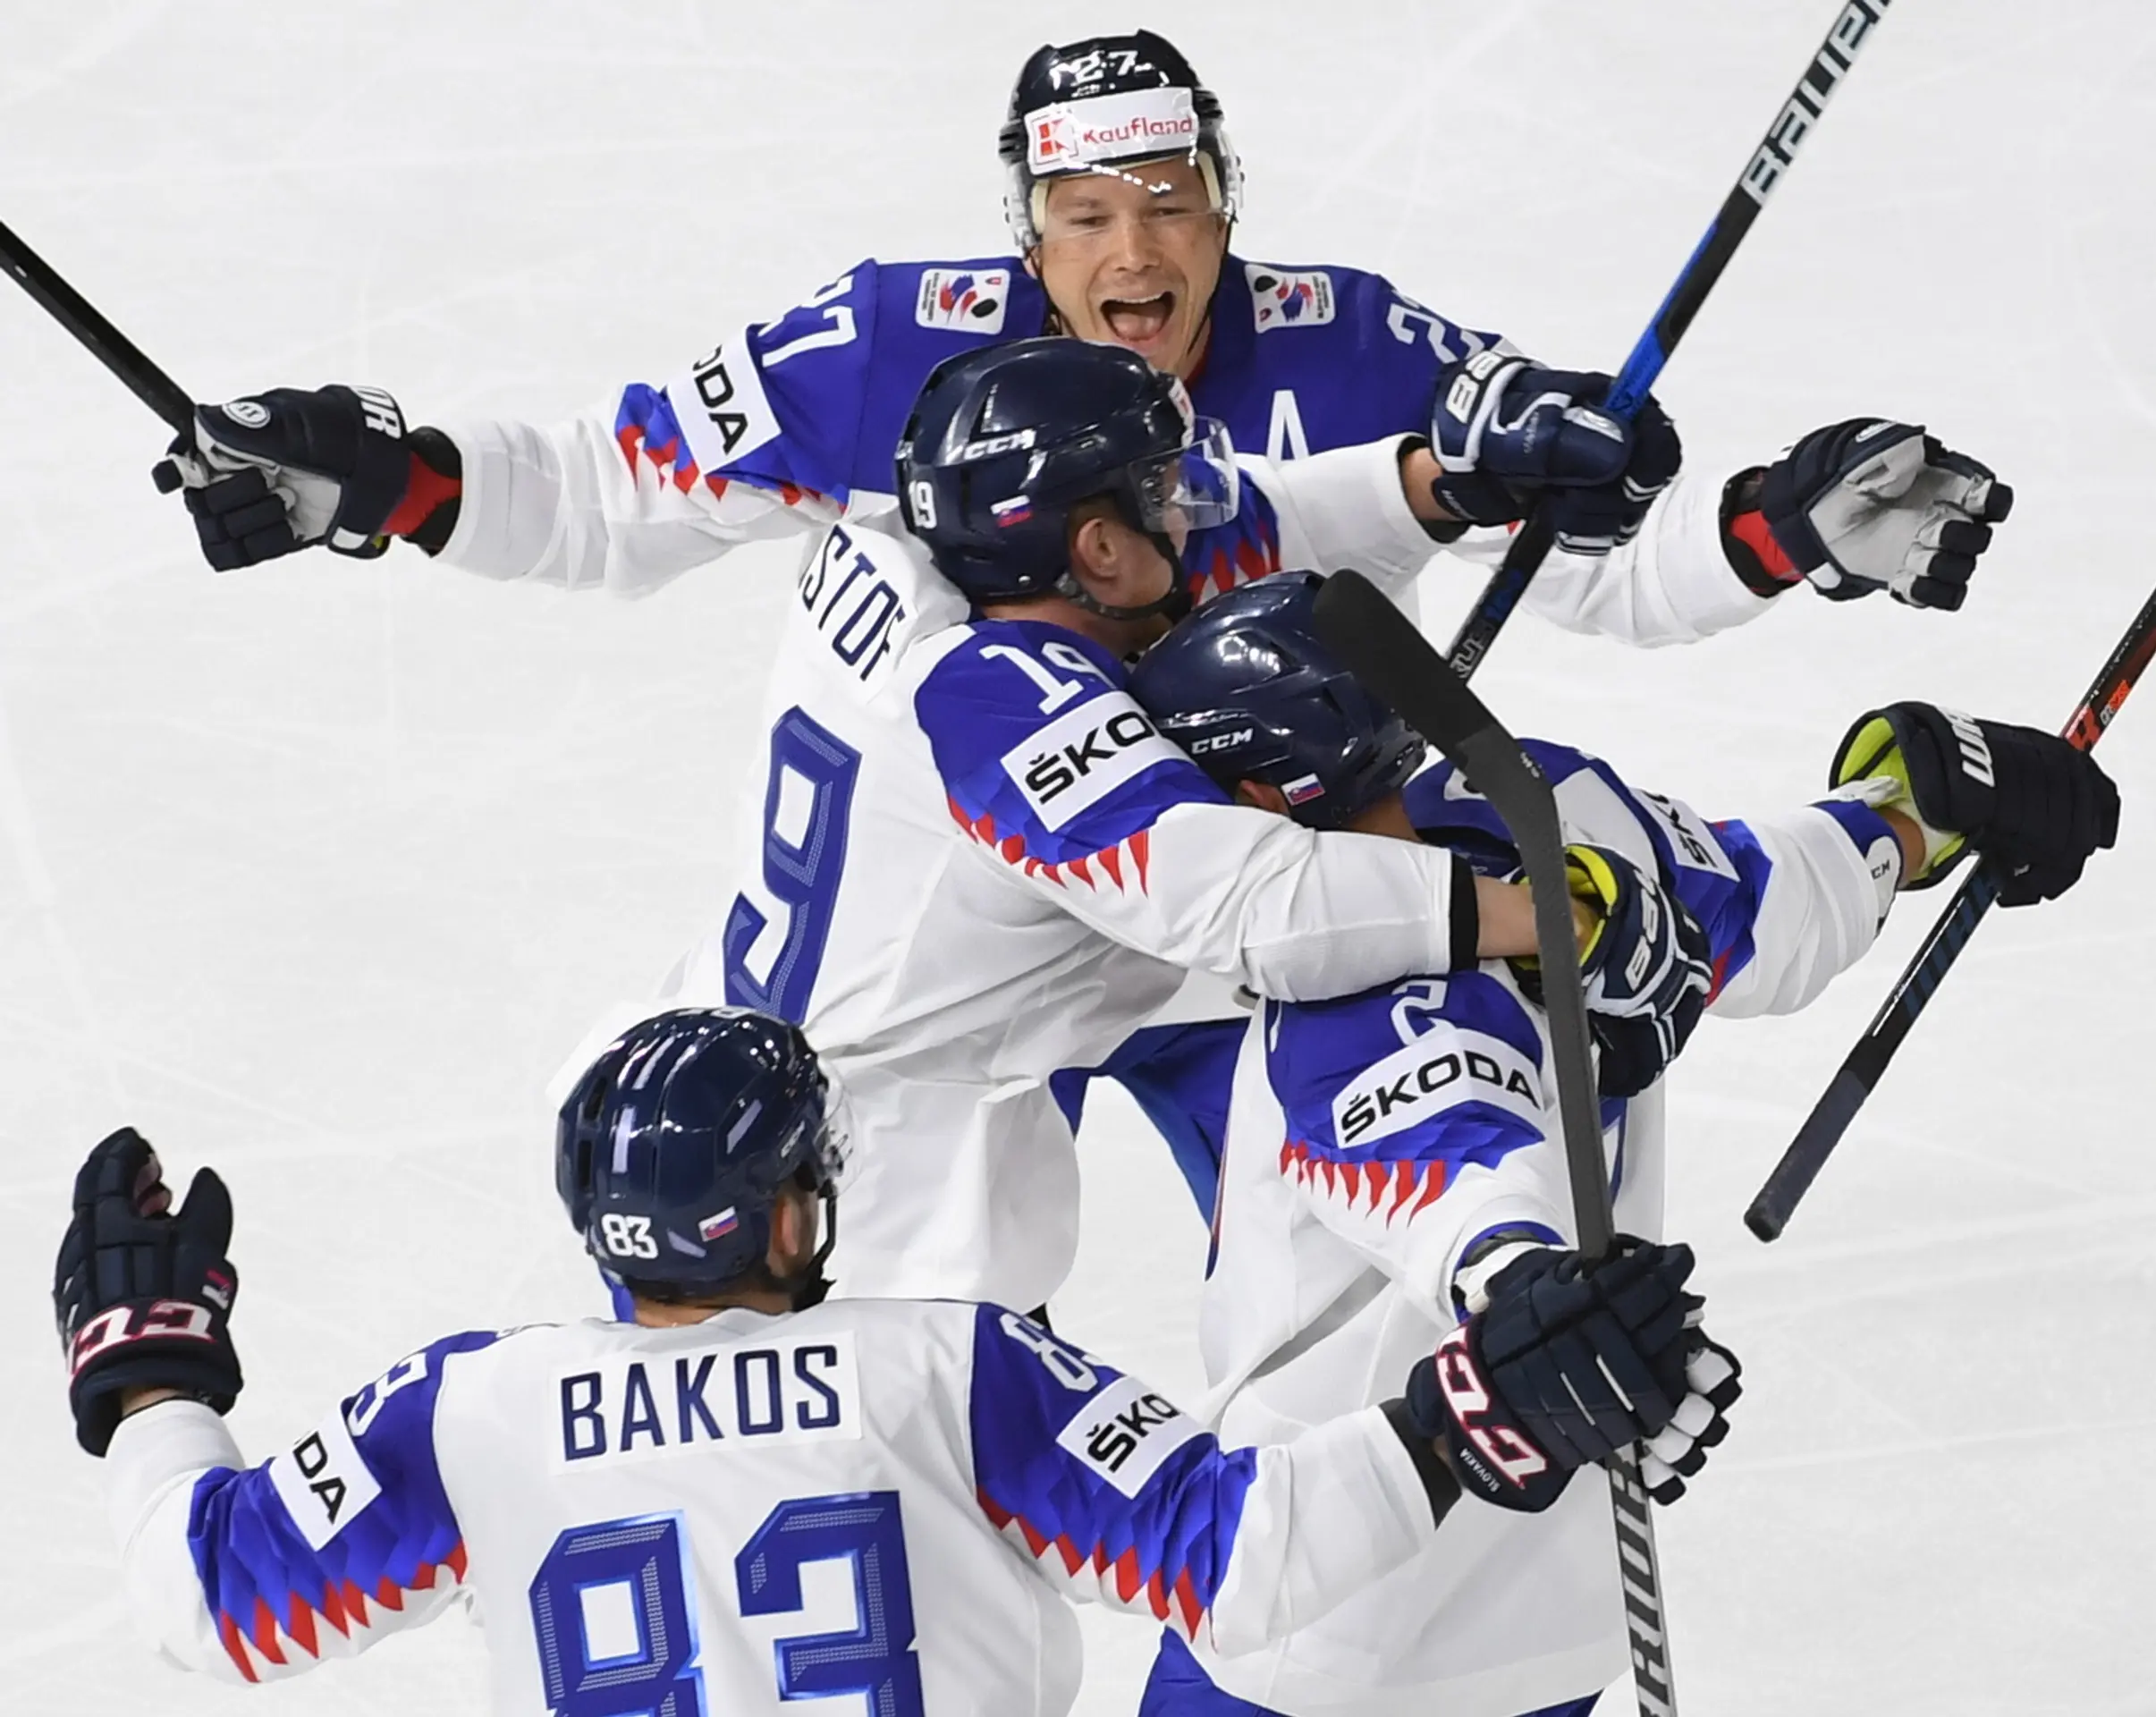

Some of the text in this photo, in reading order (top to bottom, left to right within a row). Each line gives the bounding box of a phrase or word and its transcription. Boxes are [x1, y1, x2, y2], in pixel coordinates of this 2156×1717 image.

[963, 428, 1037, 461] CCM
[1266, 389, 1311, 465] A
[1191, 728, 1254, 755] CCM
[1341, 1050, 1541, 1144] ŠKODA
[601, 1213, 659, 1259] 83
[560, 1344, 841, 1461] BAKOS
[1459, 1447, 1501, 1493] SLOVAKIA
[528, 1490, 926, 1717] 83
